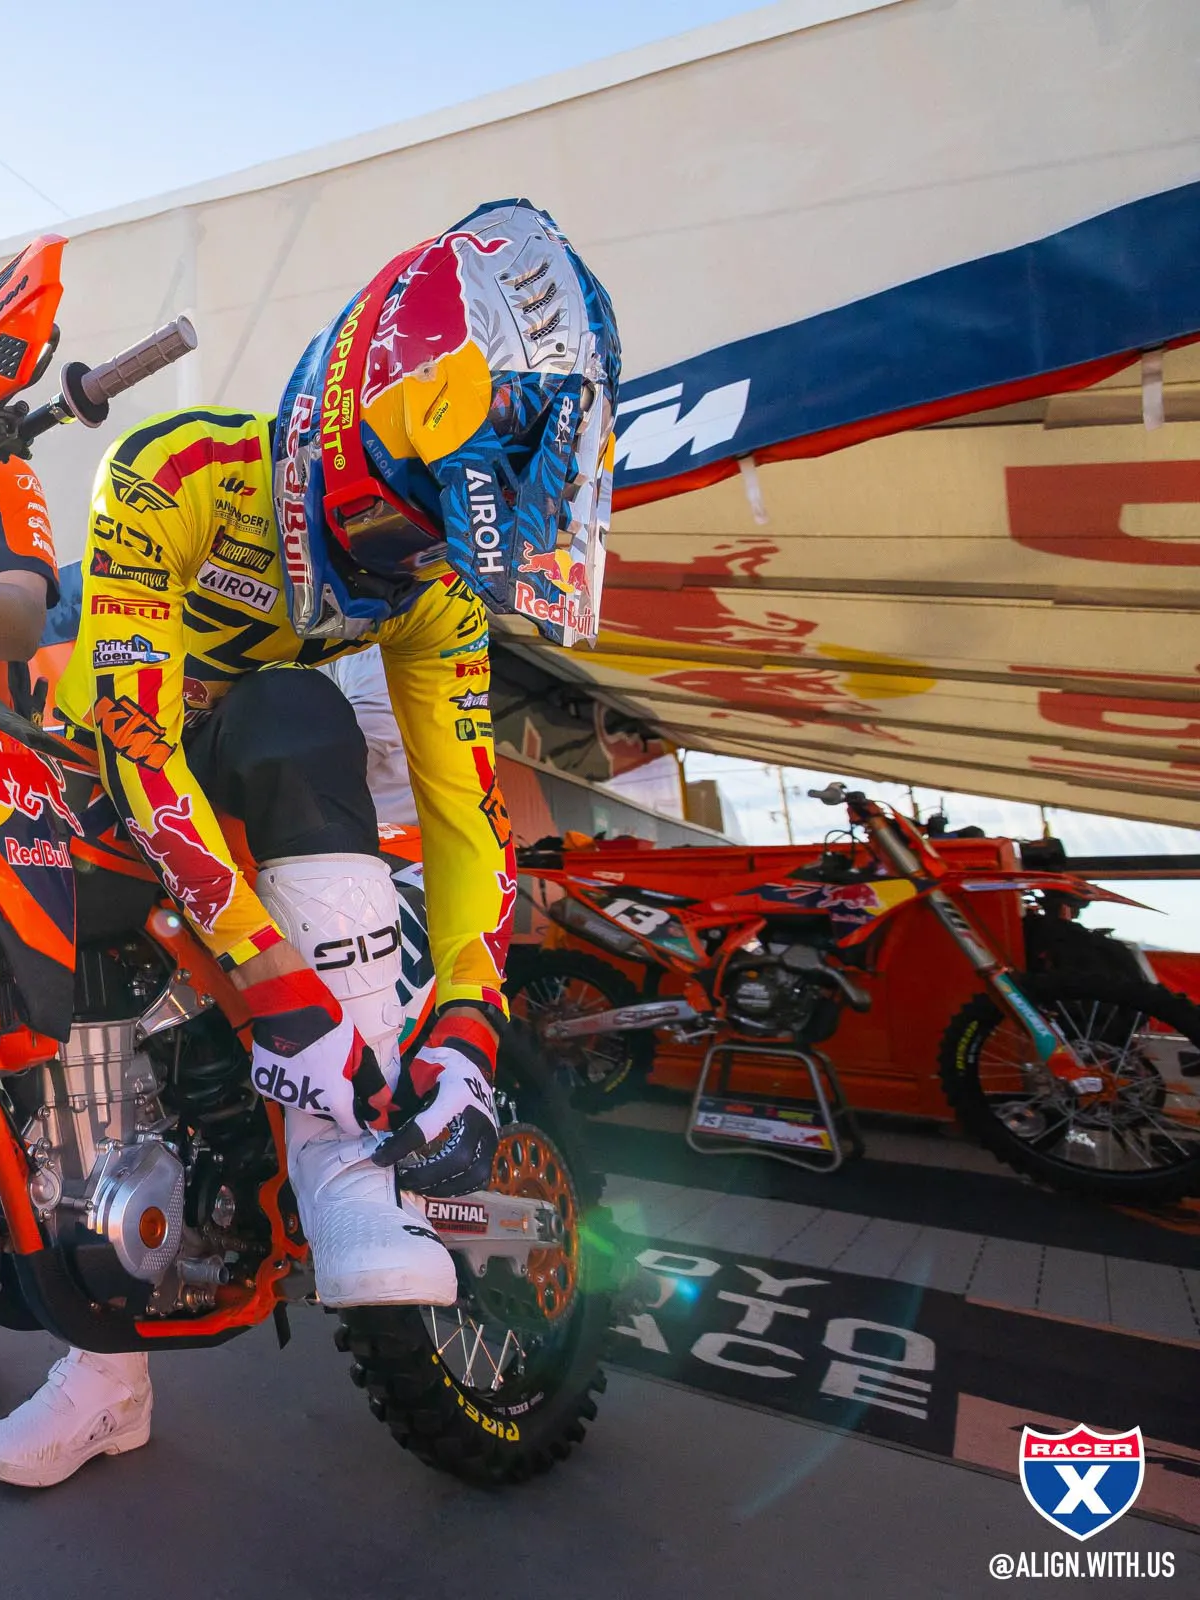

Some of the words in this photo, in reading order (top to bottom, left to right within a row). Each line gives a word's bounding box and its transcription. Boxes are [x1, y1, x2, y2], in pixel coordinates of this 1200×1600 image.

[366, 439, 394, 478] AIROH
[465, 468, 504, 573] AIROH
[200, 570, 272, 607] AIROH
[515, 580, 566, 627] Red
[91, 595, 171, 620] PIRELLI
[94, 651, 133, 664] Koen
[96, 640, 133, 652] Triki
[94, 694, 179, 773] KTM
[4, 837, 44, 867] Red
[41, 840, 73, 868] Bull
[600, 898, 671, 936] 13
[254, 1063, 331, 1112] dbk.
[426, 1202, 488, 1223] ENTHAL
